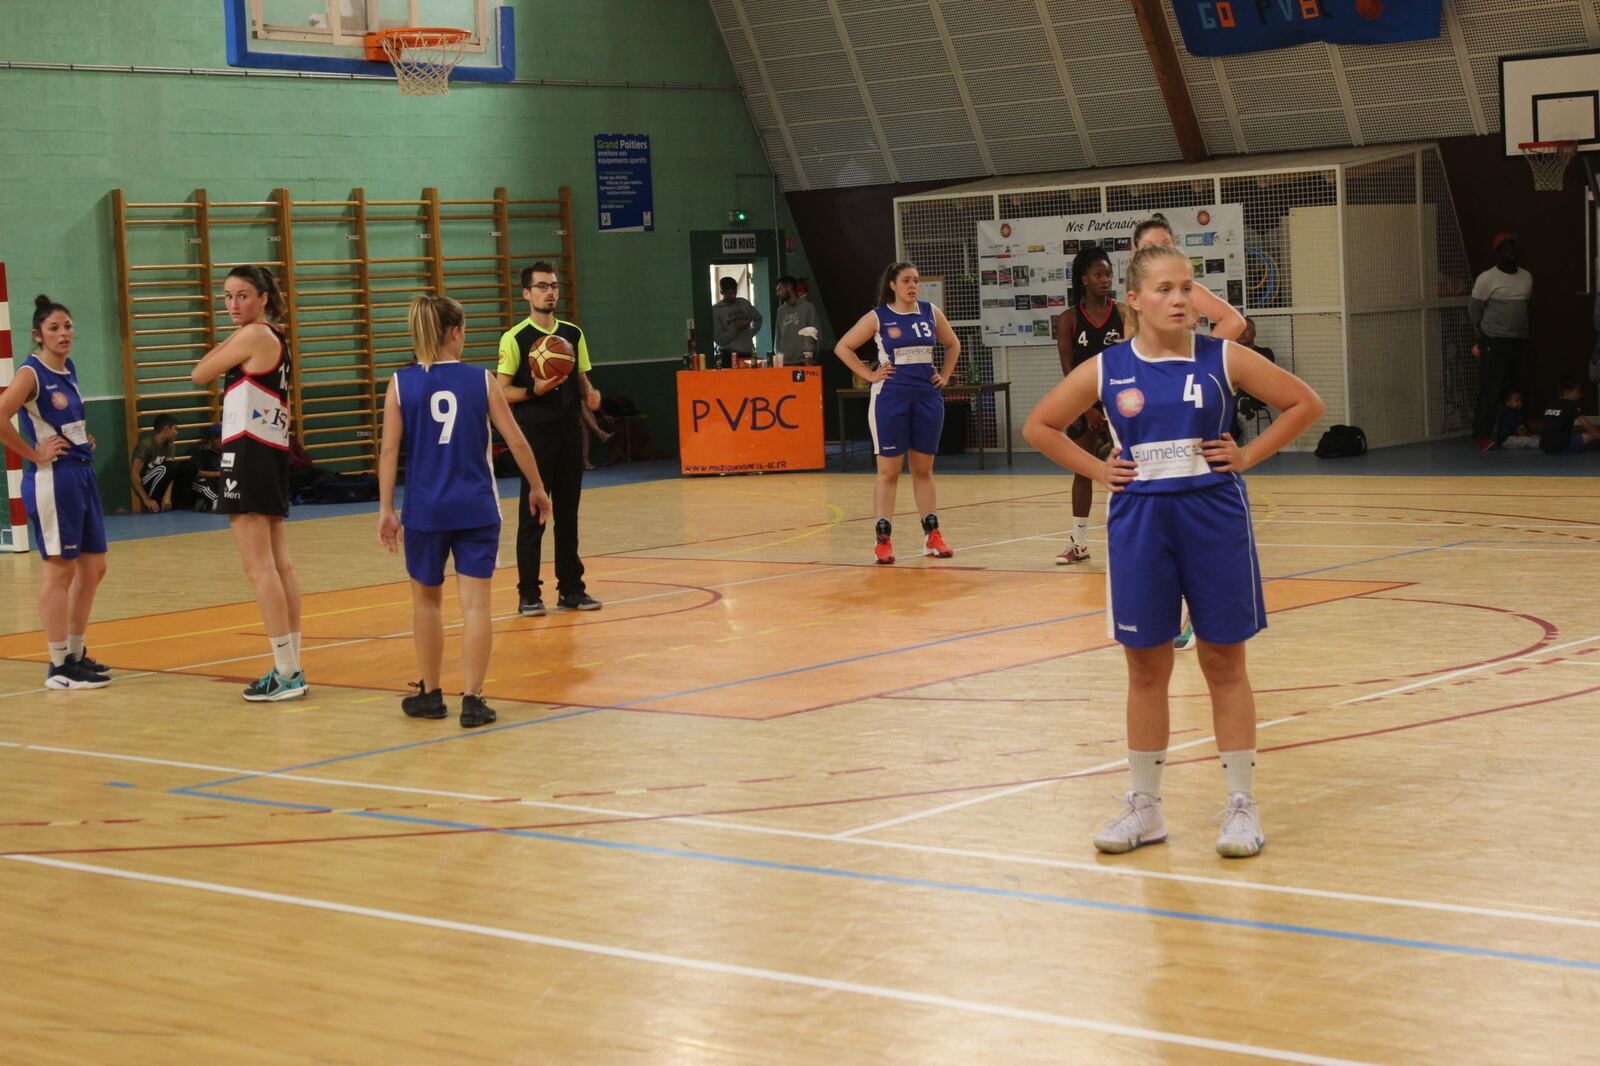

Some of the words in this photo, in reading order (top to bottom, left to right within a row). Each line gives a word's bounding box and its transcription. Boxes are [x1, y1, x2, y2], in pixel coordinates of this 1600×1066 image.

[1197, 2, 1237, 29] GO
[597, 140, 619, 149] Grand
[620, 140, 648, 149] Poitiers
[1066, 221, 1084, 232] Nos
[1087, 217, 1138, 231] Partenair
[724, 238, 737, 249] CLUB
[738, 238, 755, 249] HOUSE
[911, 322, 932, 338] 13
[1078, 331, 1088, 347] 4
[1183, 373, 1203, 408] 4
[430, 390, 458, 445] 9
[692, 394, 799, 433] PVBC
